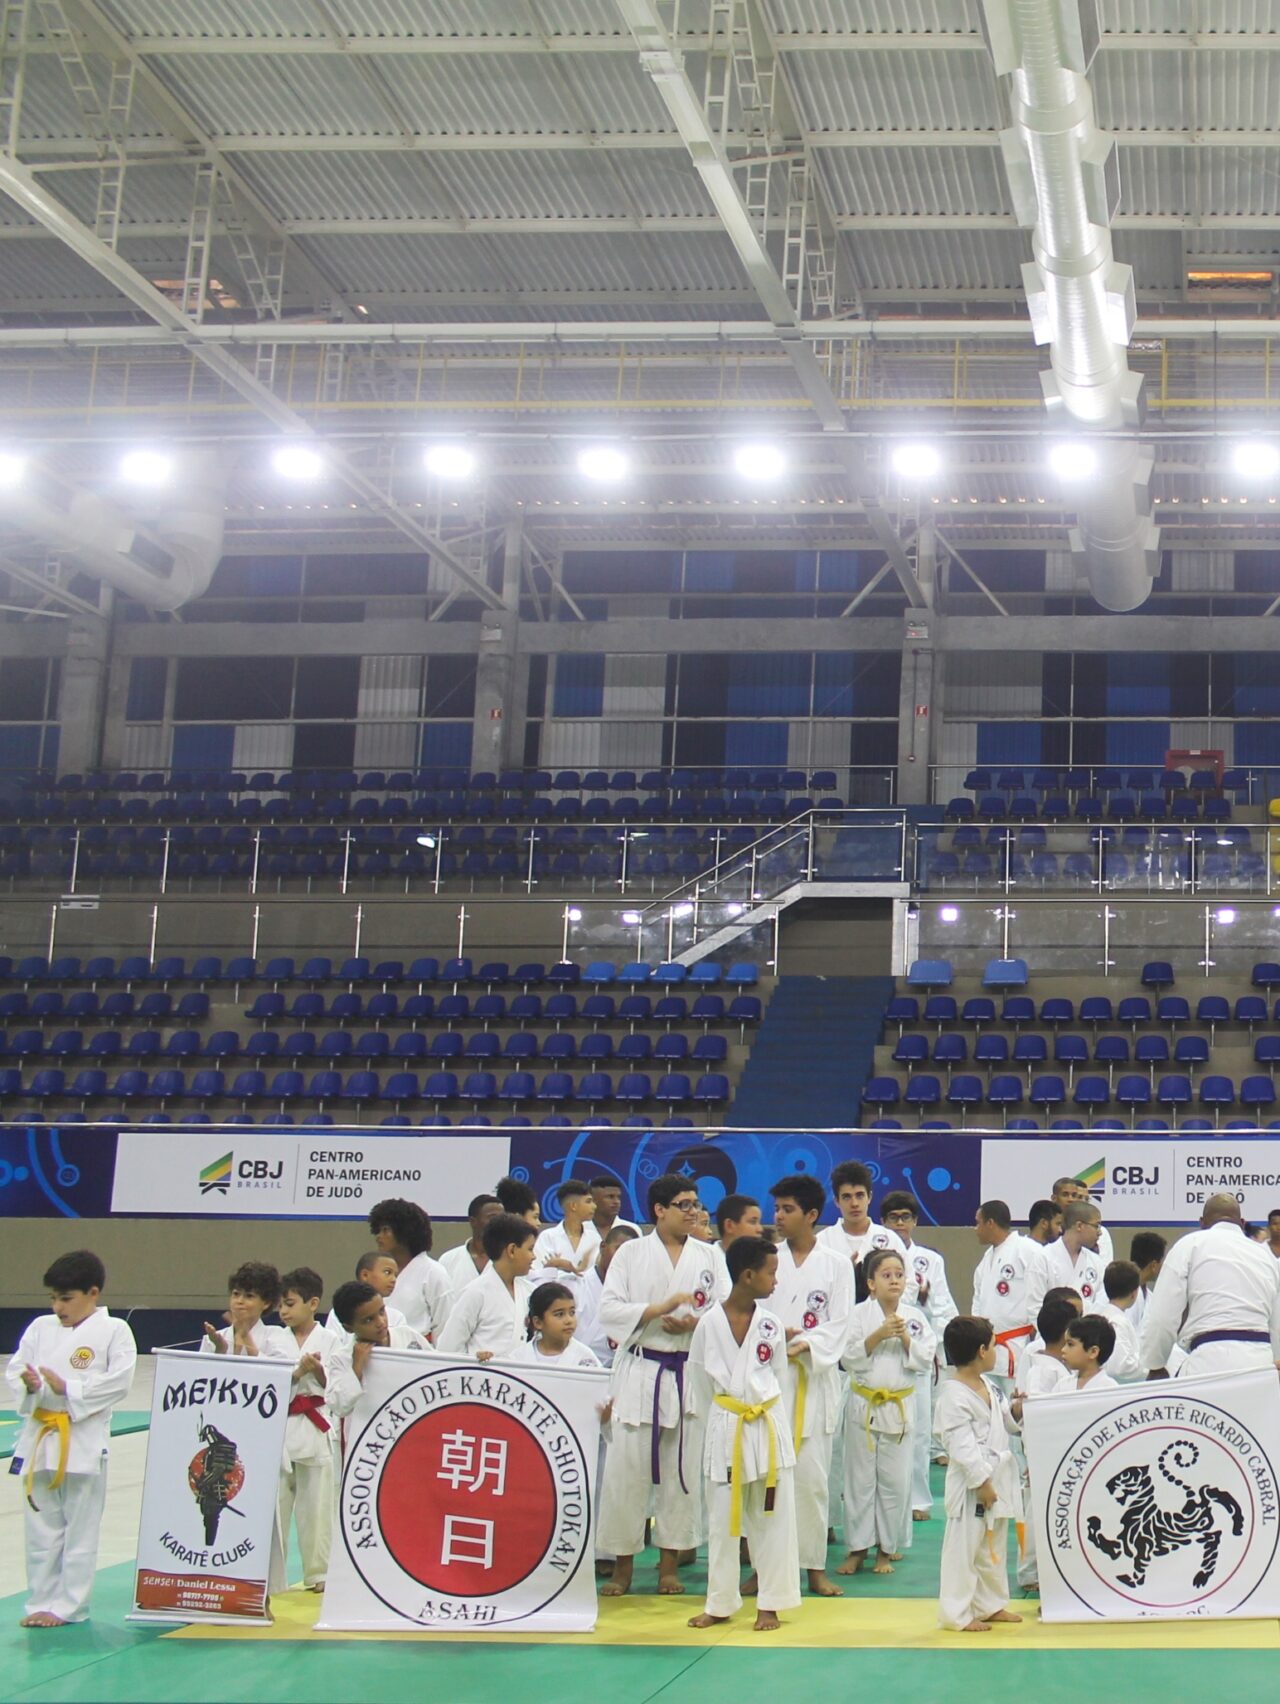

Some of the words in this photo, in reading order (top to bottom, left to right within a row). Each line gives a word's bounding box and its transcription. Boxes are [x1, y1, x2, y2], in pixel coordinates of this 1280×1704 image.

[310, 1151, 364, 1163] CENTRO
[1186, 1156, 1243, 1168] CENTRO
[238, 1160, 283, 1179] CBJ
[308, 1168, 422, 1181] PAN-AMERICANO
[1112, 1166, 1159, 1186] CBJ
[237, 1181, 282, 1189] BRASIL
[306, 1186, 325, 1198] DE
[328, 1184, 363, 1199] JUDÔ
[1186, 1192, 1205, 1203] DE
[163, 1377, 278, 1419] MEIKYÔ
[350, 1396, 417, 1550] ASSOCIAÇÃO
[420, 1378, 451, 1405] DE
[460, 1376, 558, 1436] KARATÊ
[548, 1435, 583, 1574] SHOTOKAN
[1055, 1449, 1095, 1550] ASSOCIAÇÃO
[1091, 1427, 1115, 1450] DE
[1114, 1403, 1185, 1434] KARATÊ
[1189, 1409, 1252, 1456] RICARDO
[1247, 1455, 1277, 1526] CABRAL
[436, 1429, 508, 1570] 朝日
[159, 1531, 209, 1567] KARATÊ
[211, 1537, 255, 1567] CLUBE
[176, 1579, 208, 1589] Daniel
[209, 1581, 236, 1592] Lessa
[419, 1600, 499, 1622] ASAHI
